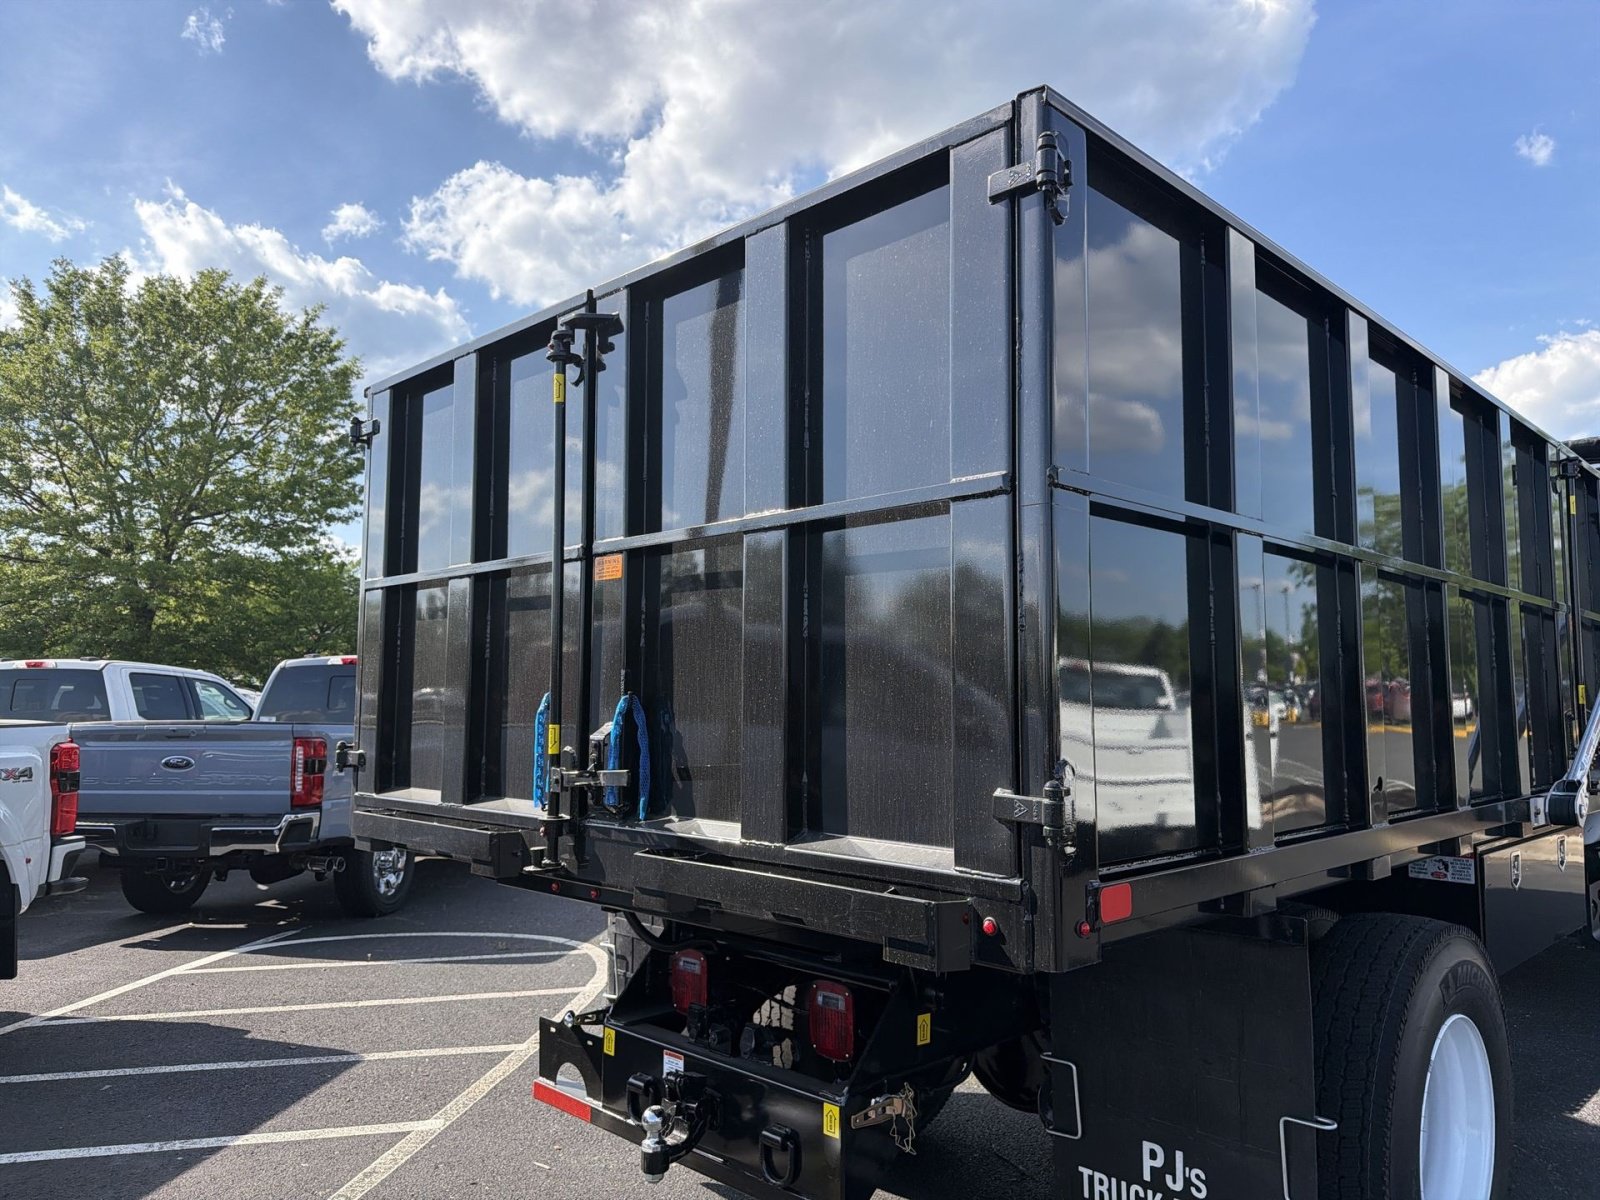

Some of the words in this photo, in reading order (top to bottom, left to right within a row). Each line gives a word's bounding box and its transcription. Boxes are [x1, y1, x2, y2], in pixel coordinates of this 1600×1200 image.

[0, 766, 33, 781] X4
[82, 776, 186, 785] SUPER
[195, 774, 279, 786] DUTY
